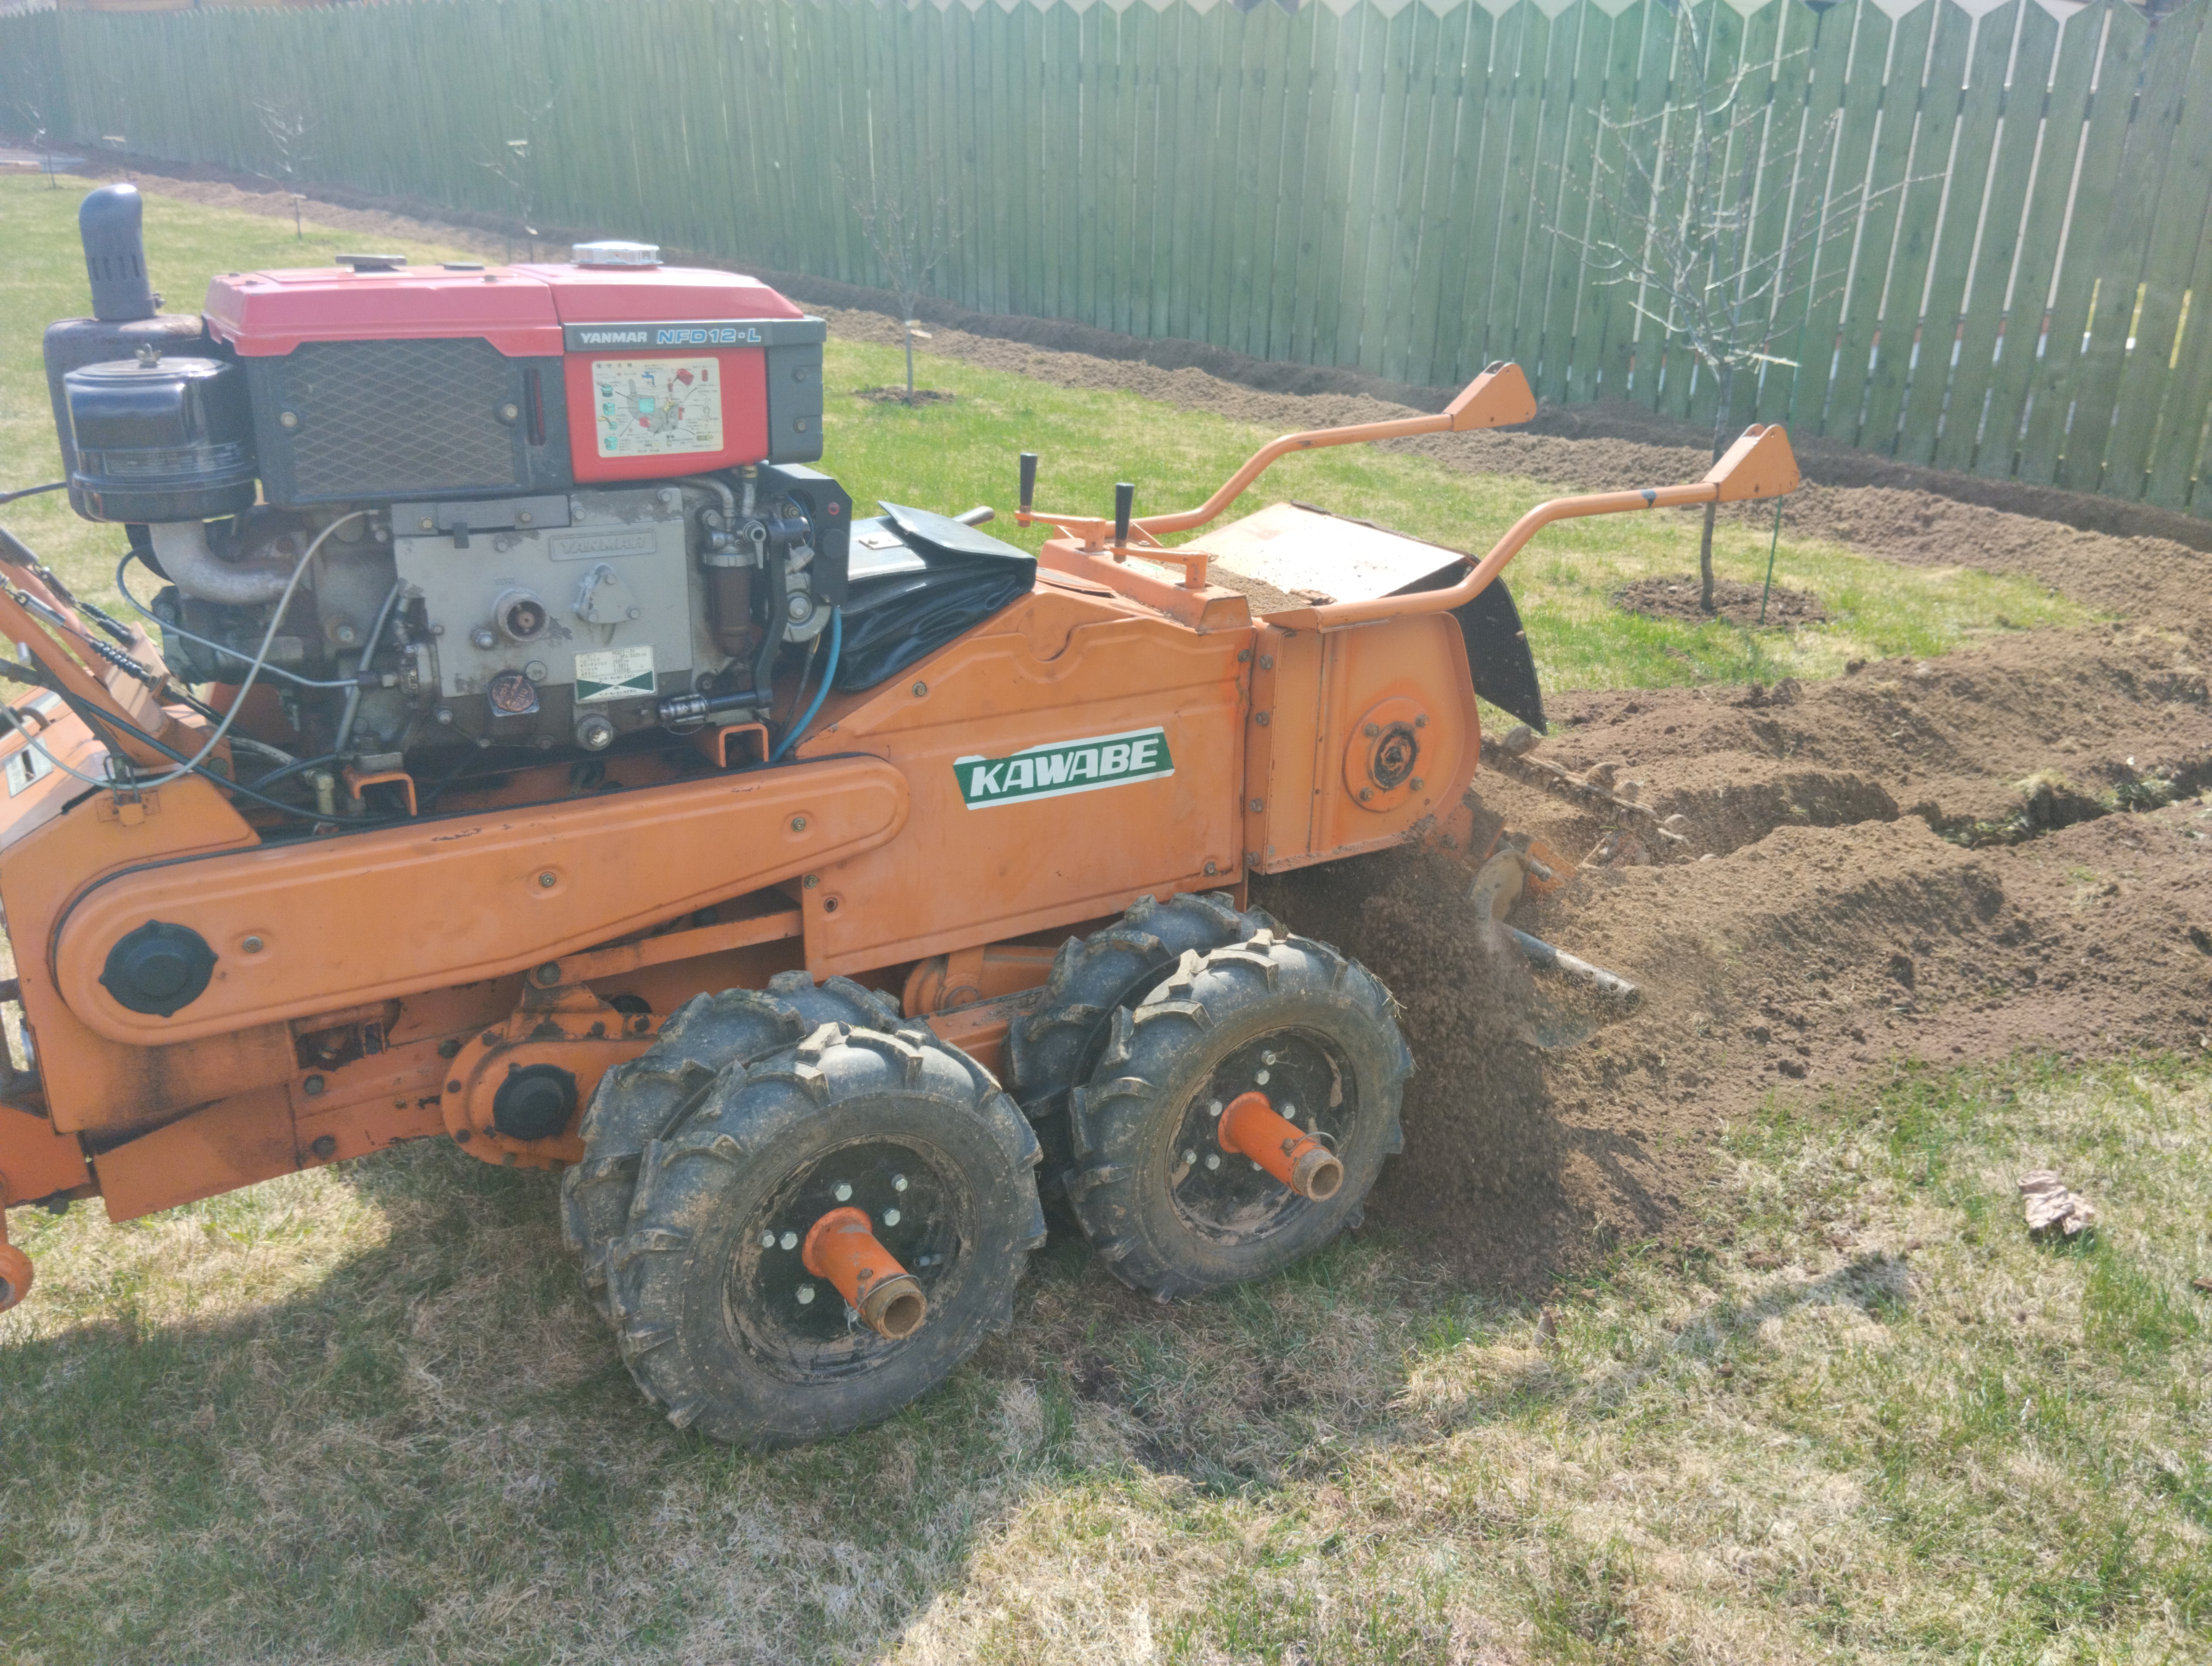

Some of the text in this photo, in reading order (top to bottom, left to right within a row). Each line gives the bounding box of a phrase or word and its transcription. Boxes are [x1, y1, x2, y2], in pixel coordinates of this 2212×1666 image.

[581, 331, 647, 344] YANMAR
[560, 535, 645, 554] YANMAR
[970, 738, 1159, 797] KAWABE
